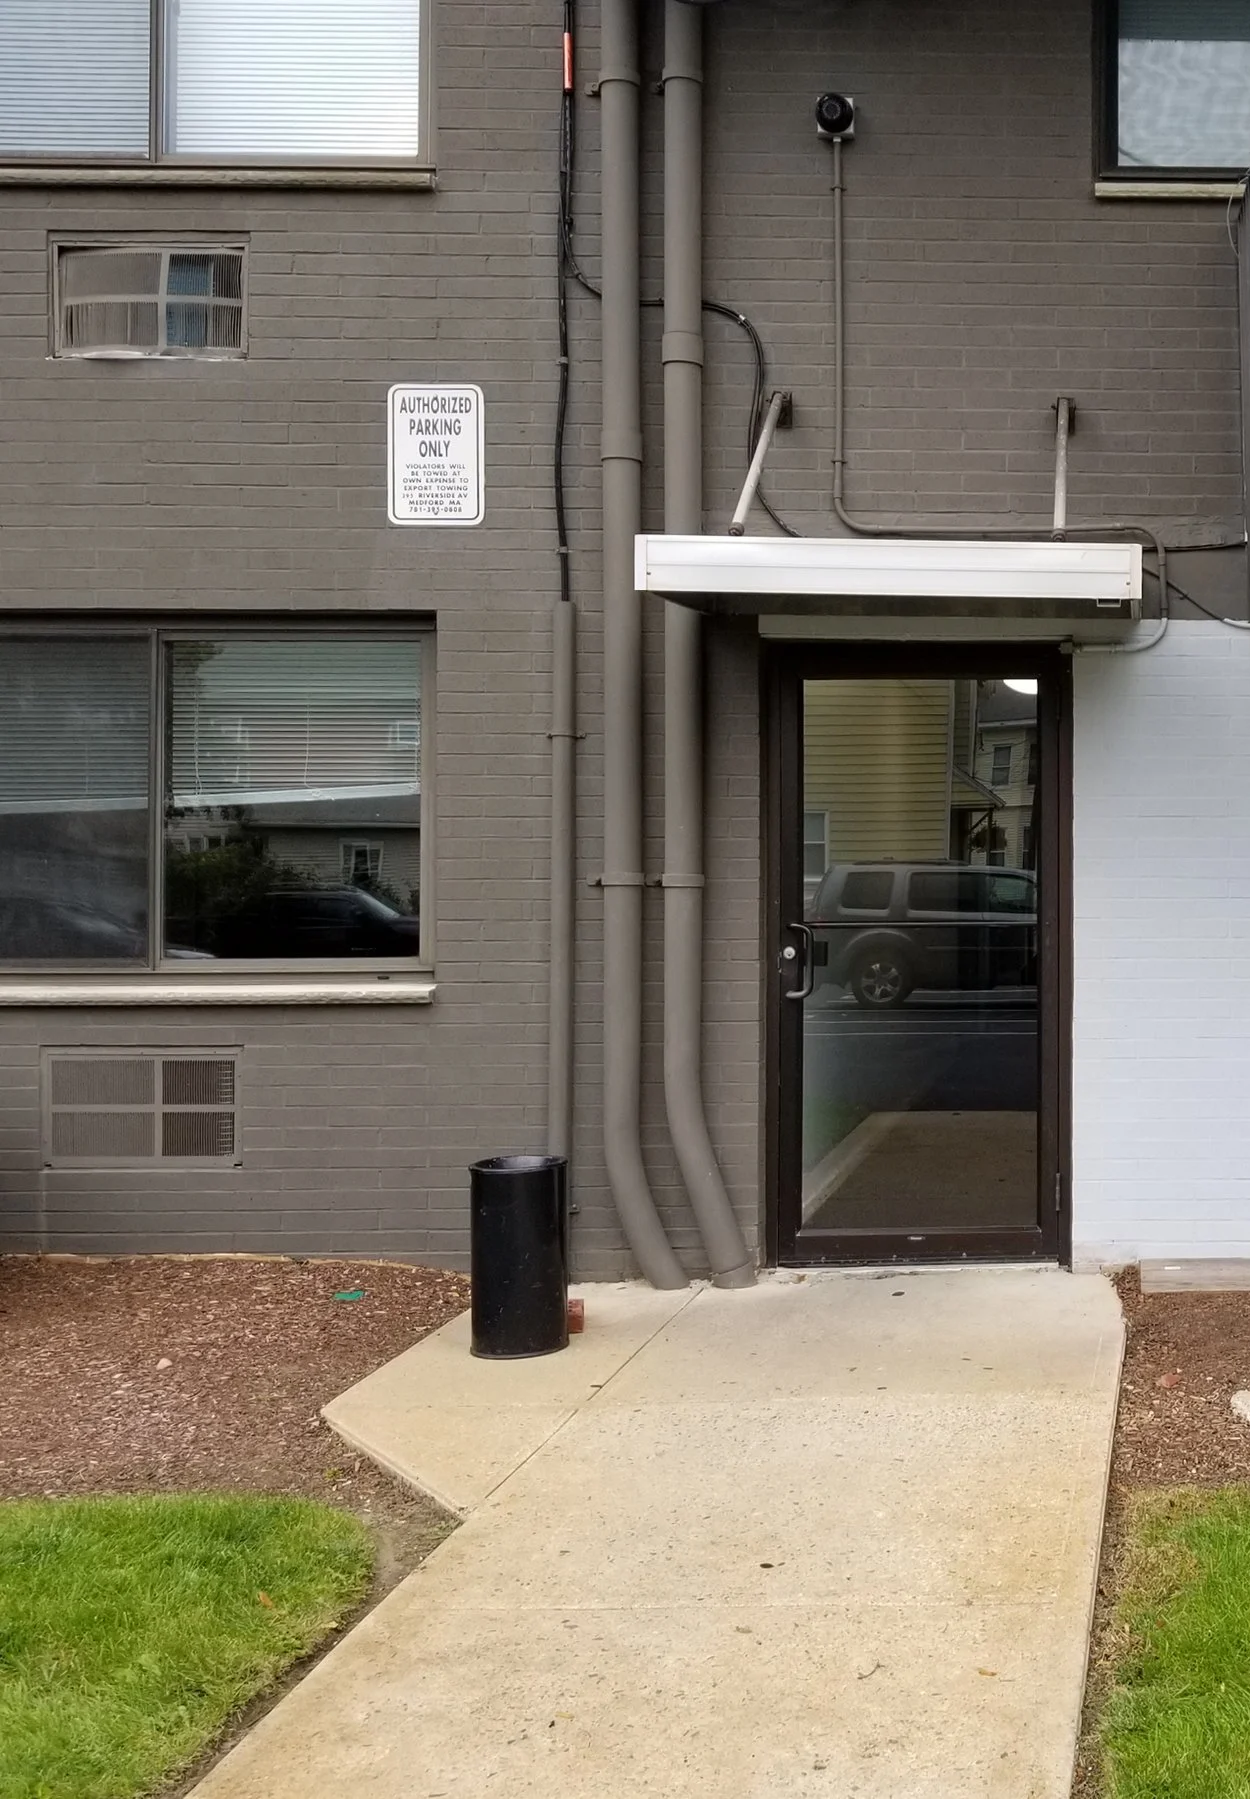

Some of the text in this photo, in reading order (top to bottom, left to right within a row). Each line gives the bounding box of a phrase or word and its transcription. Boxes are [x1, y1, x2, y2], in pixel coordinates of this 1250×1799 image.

[399, 396, 472, 414] AUTHORIZED
[409, 418, 462, 436] PARKING
[418, 440, 451, 458] ONLY
